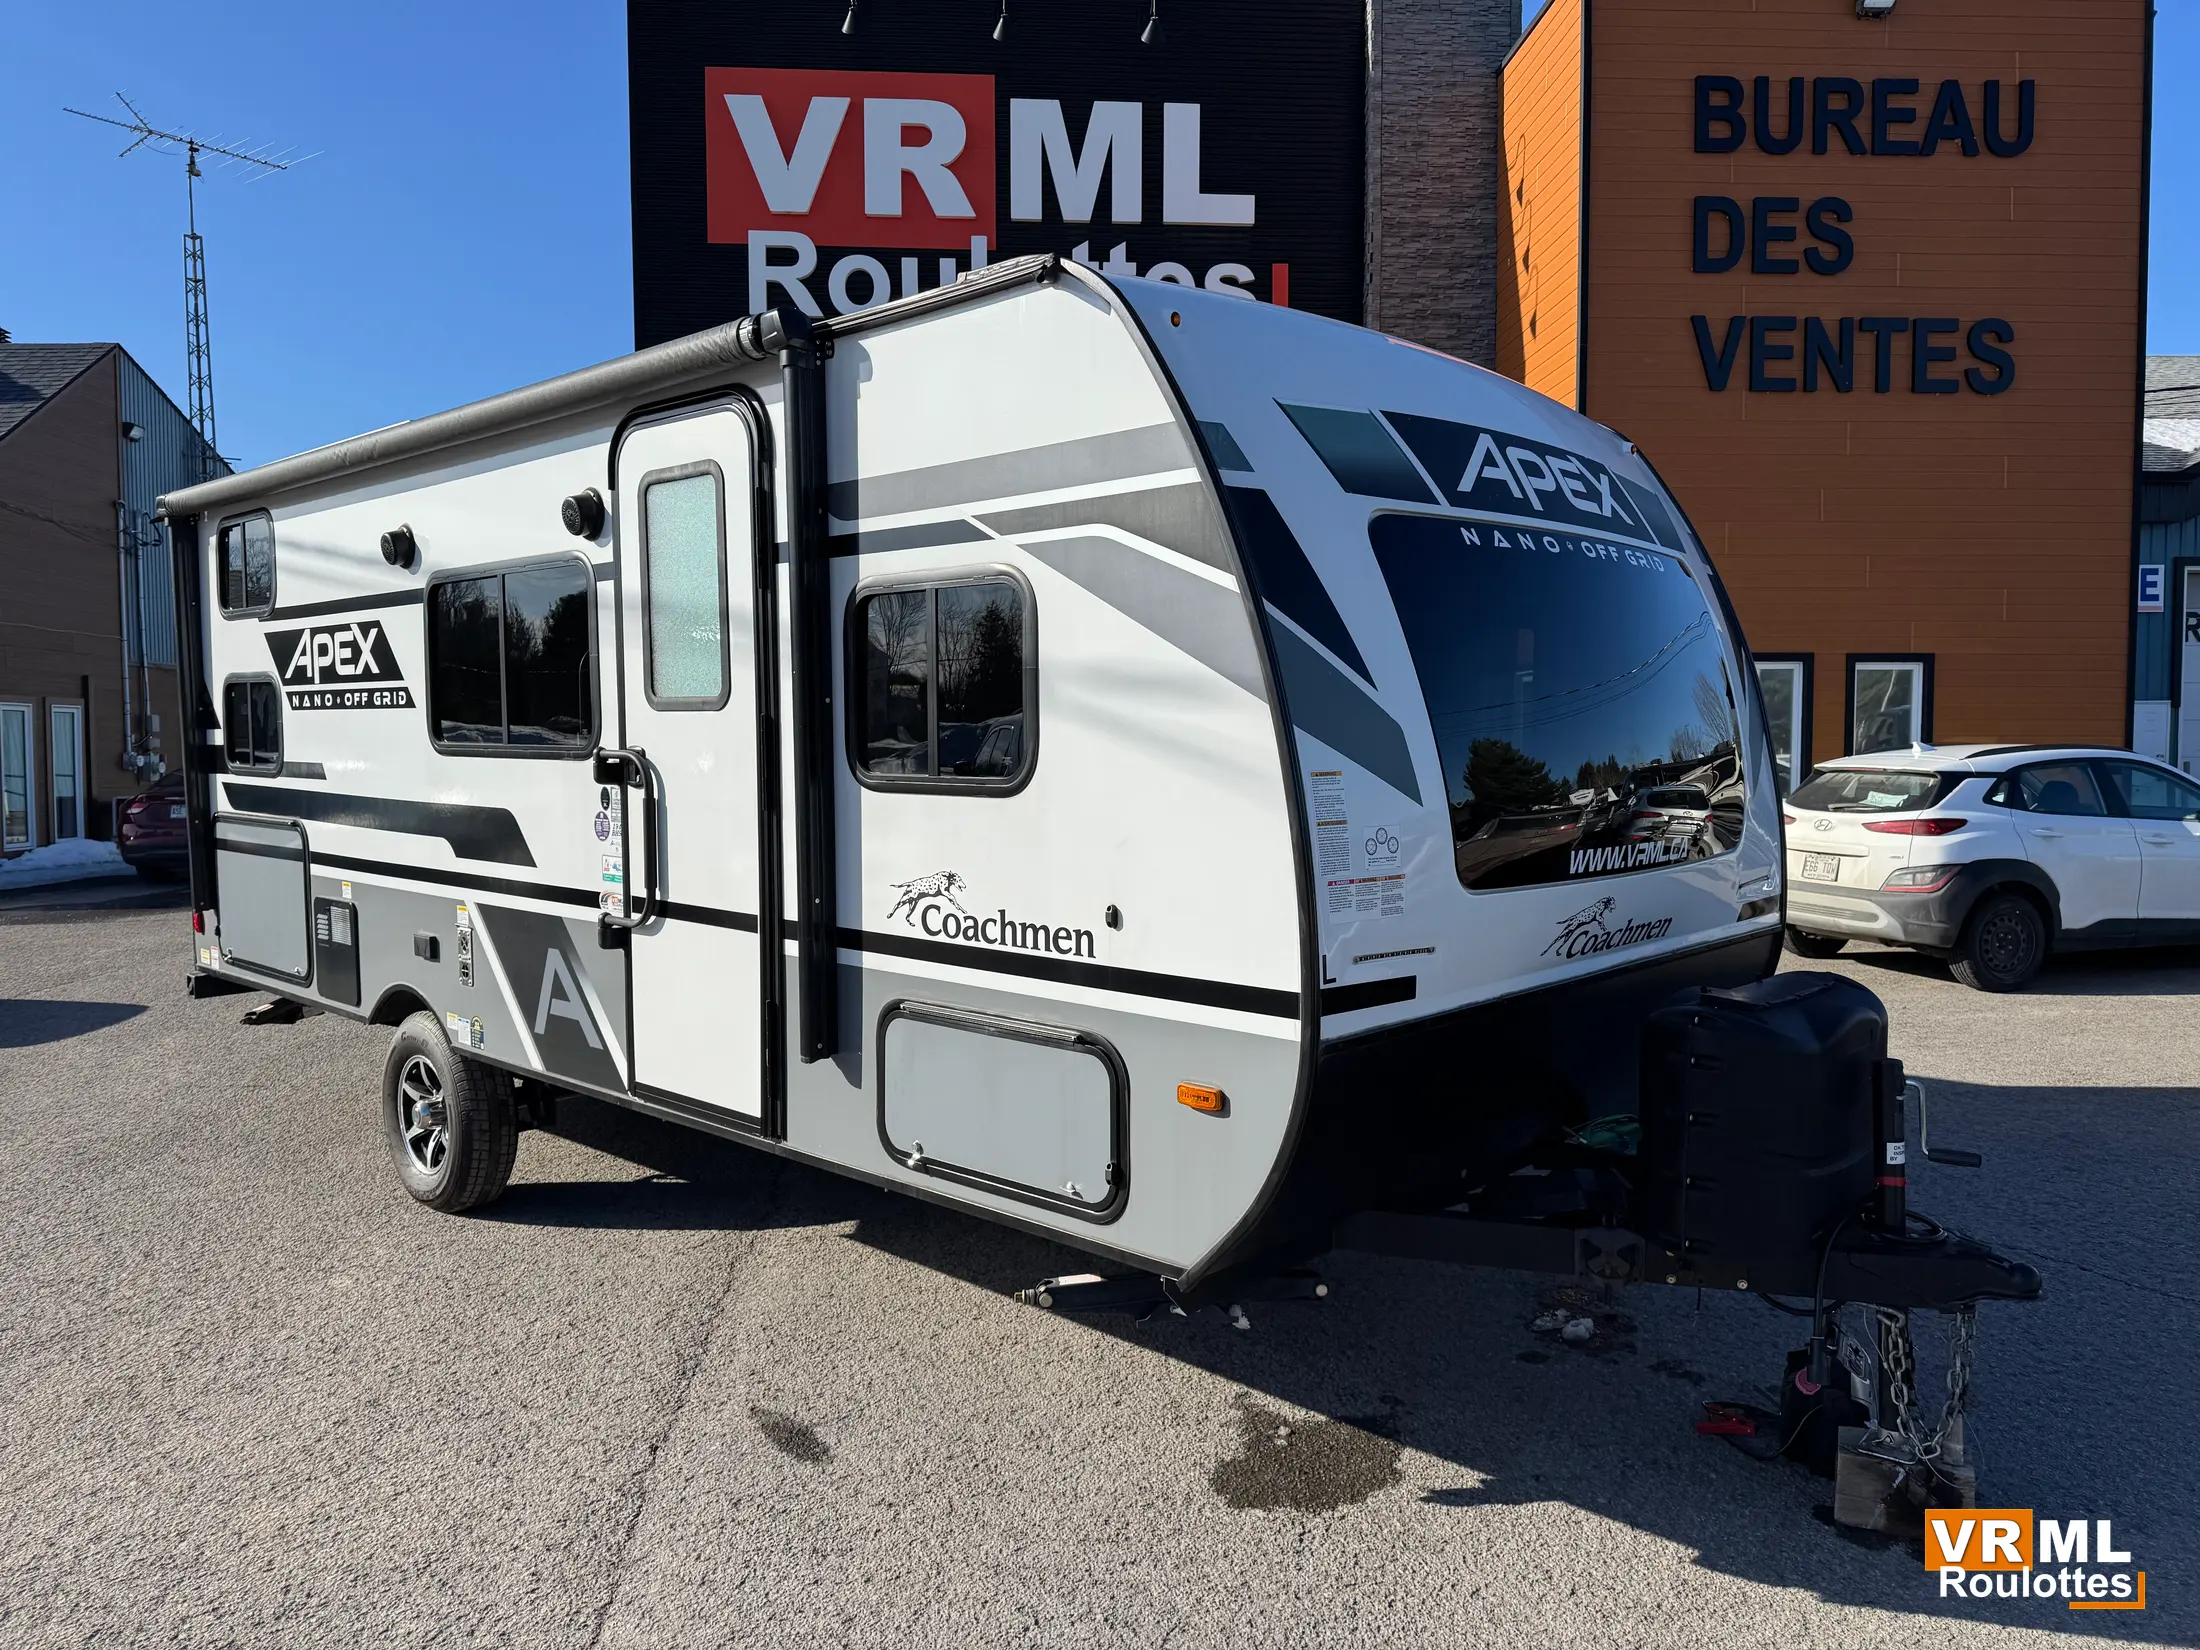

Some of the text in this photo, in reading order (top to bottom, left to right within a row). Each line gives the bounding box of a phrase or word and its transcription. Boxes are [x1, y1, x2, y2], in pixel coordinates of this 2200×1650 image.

[1694, 75, 2035, 158] BUREAU
[723, 94, 1255, 226] VRML
[1692, 195, 1855, 275] DES
[1690, 314, 2016, 395] VENTES
[1457, 433, 1635, 526] APEX
[1460, 526, 1665, 572] NANO OFF GRID
[2139, 568, 2160, 602] E
[284, 623, 380, 684] APEX
[292, 691, 407, 707] NANO OFF GRID
[1569, 837, 1688, 874] WWW.VRML.CA
[921, 904, 1096, 959] Coachmen
[1566, 914, 1673, 959] Coachmen
